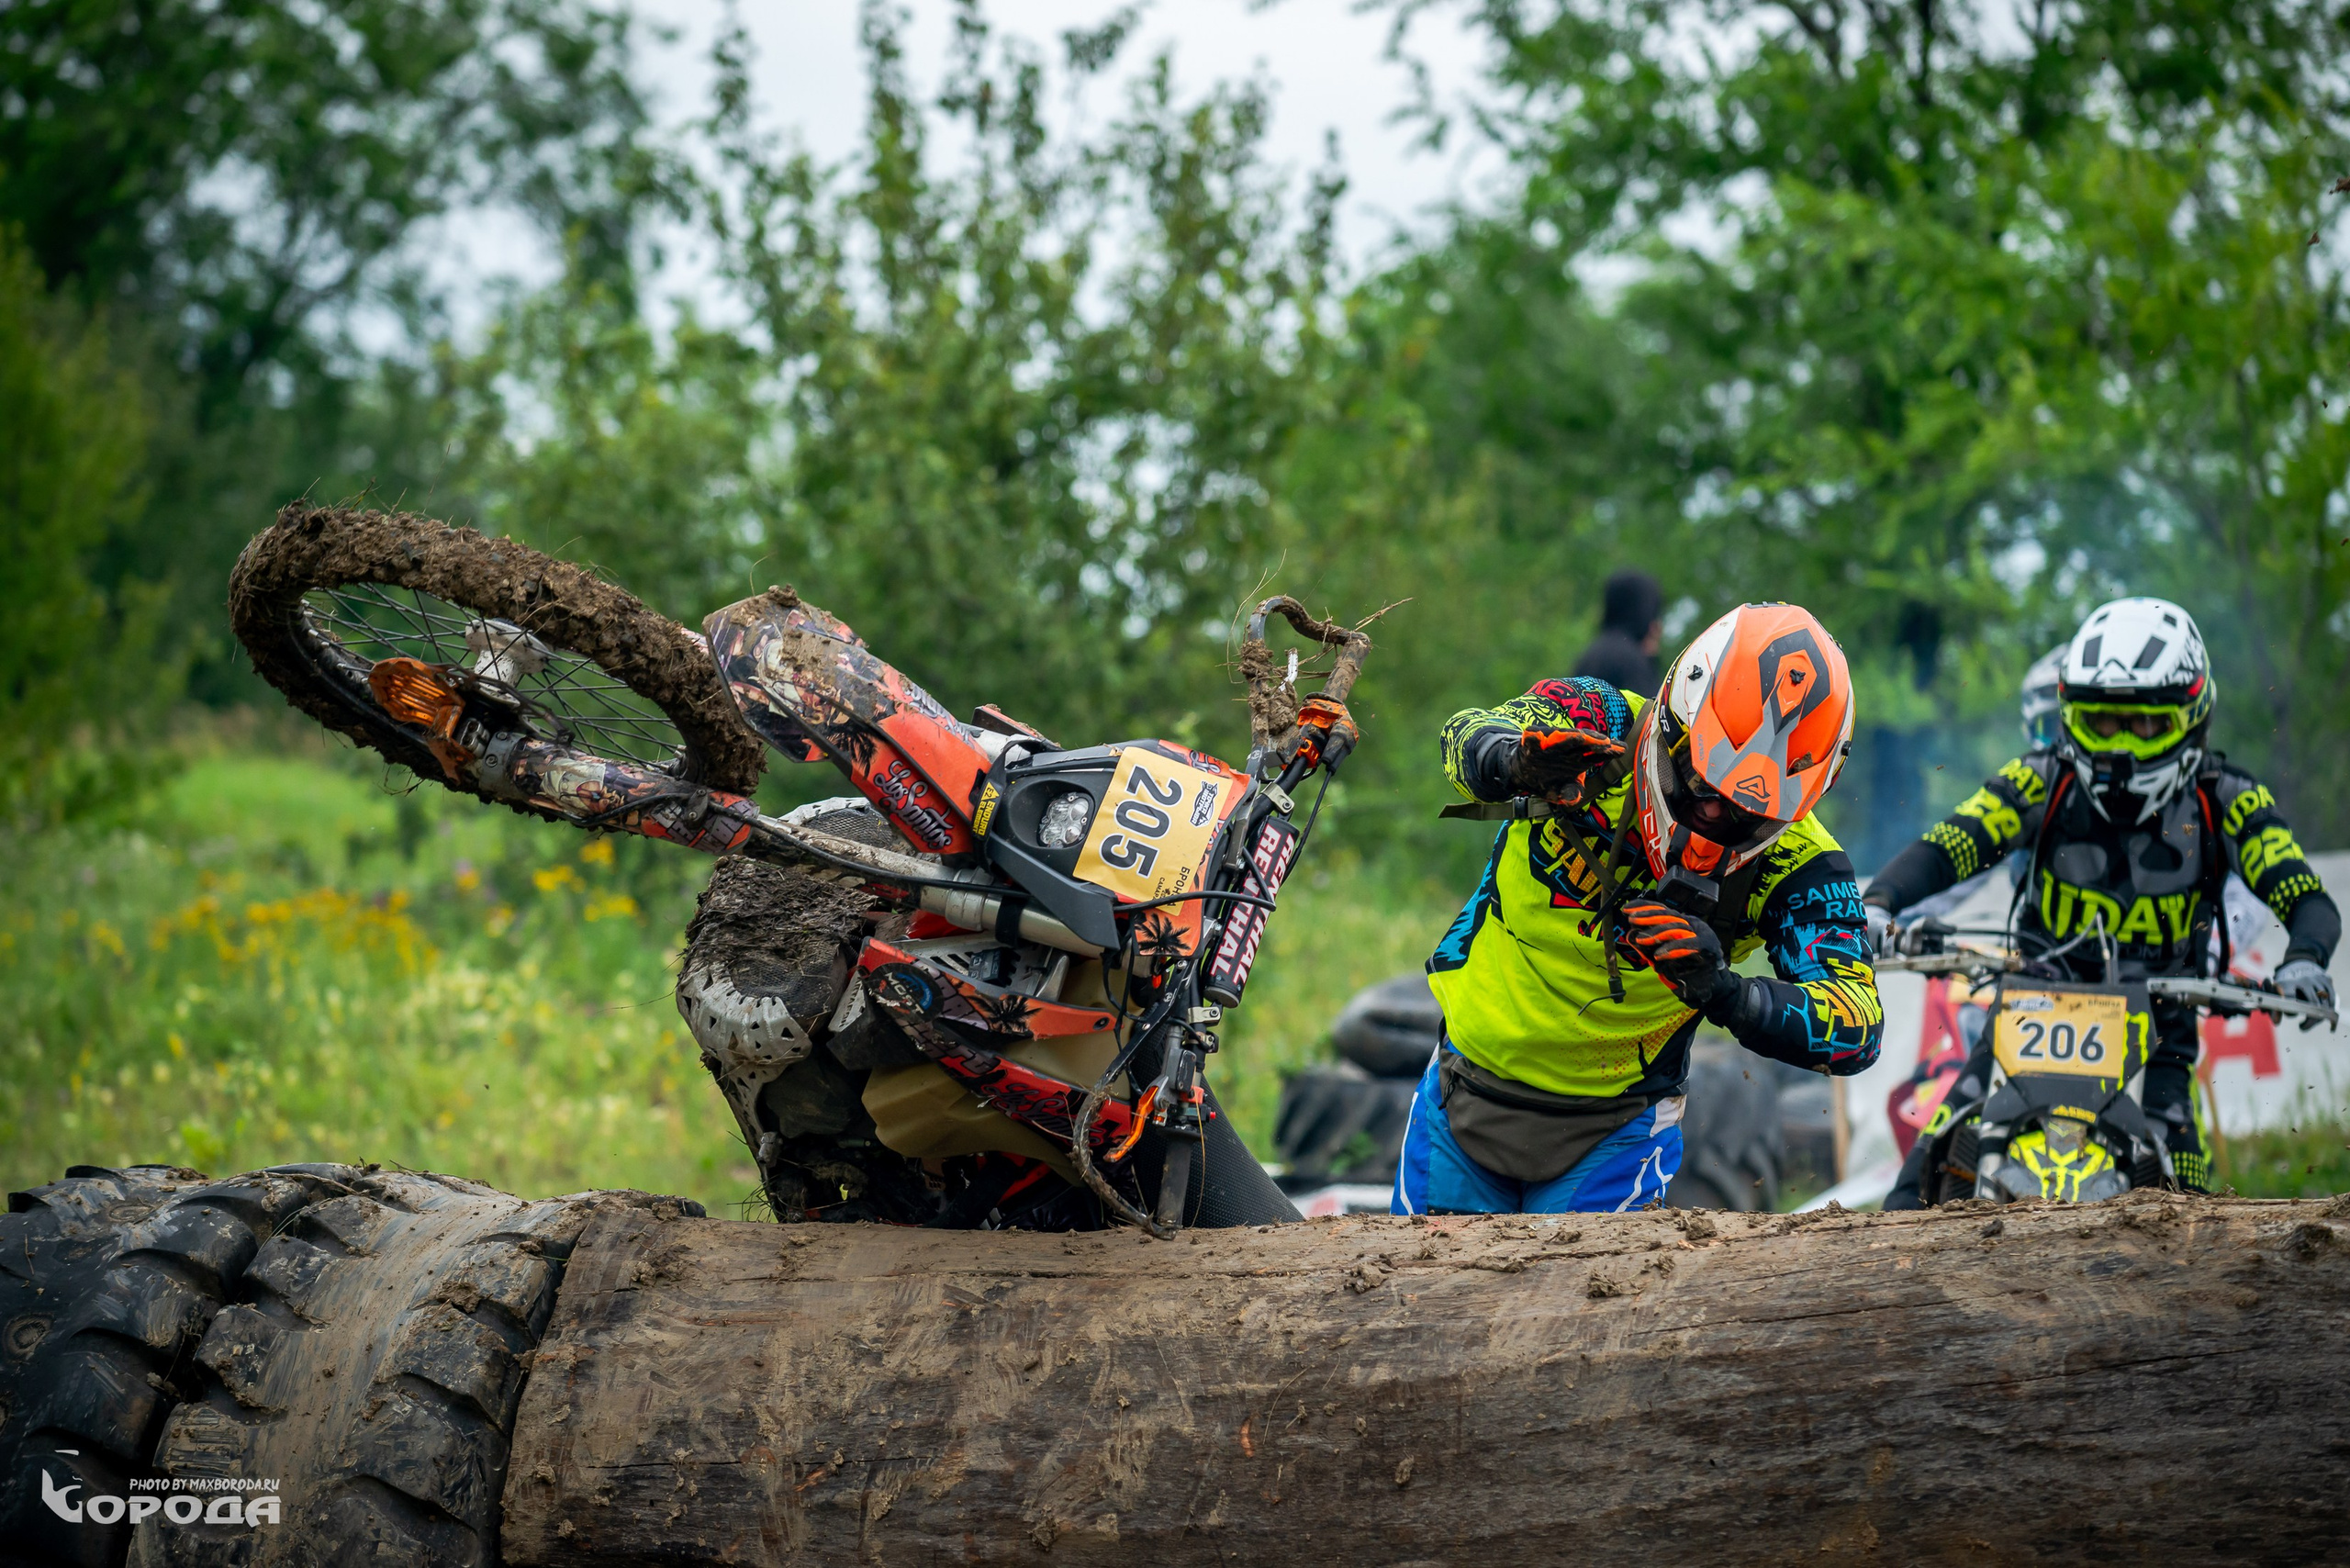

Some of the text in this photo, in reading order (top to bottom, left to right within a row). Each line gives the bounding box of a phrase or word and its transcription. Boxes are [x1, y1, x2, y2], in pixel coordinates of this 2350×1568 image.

[874, 760, 912, 801] Los
[878, 780, 955, 850] Santos
[978, 801, 996, 836] ENDURO
[1100, 764, 1183, 879] 205
[1210, 823, 1281, 977] RENTHAL
[2018, 1020, 2105, 1065] 206
